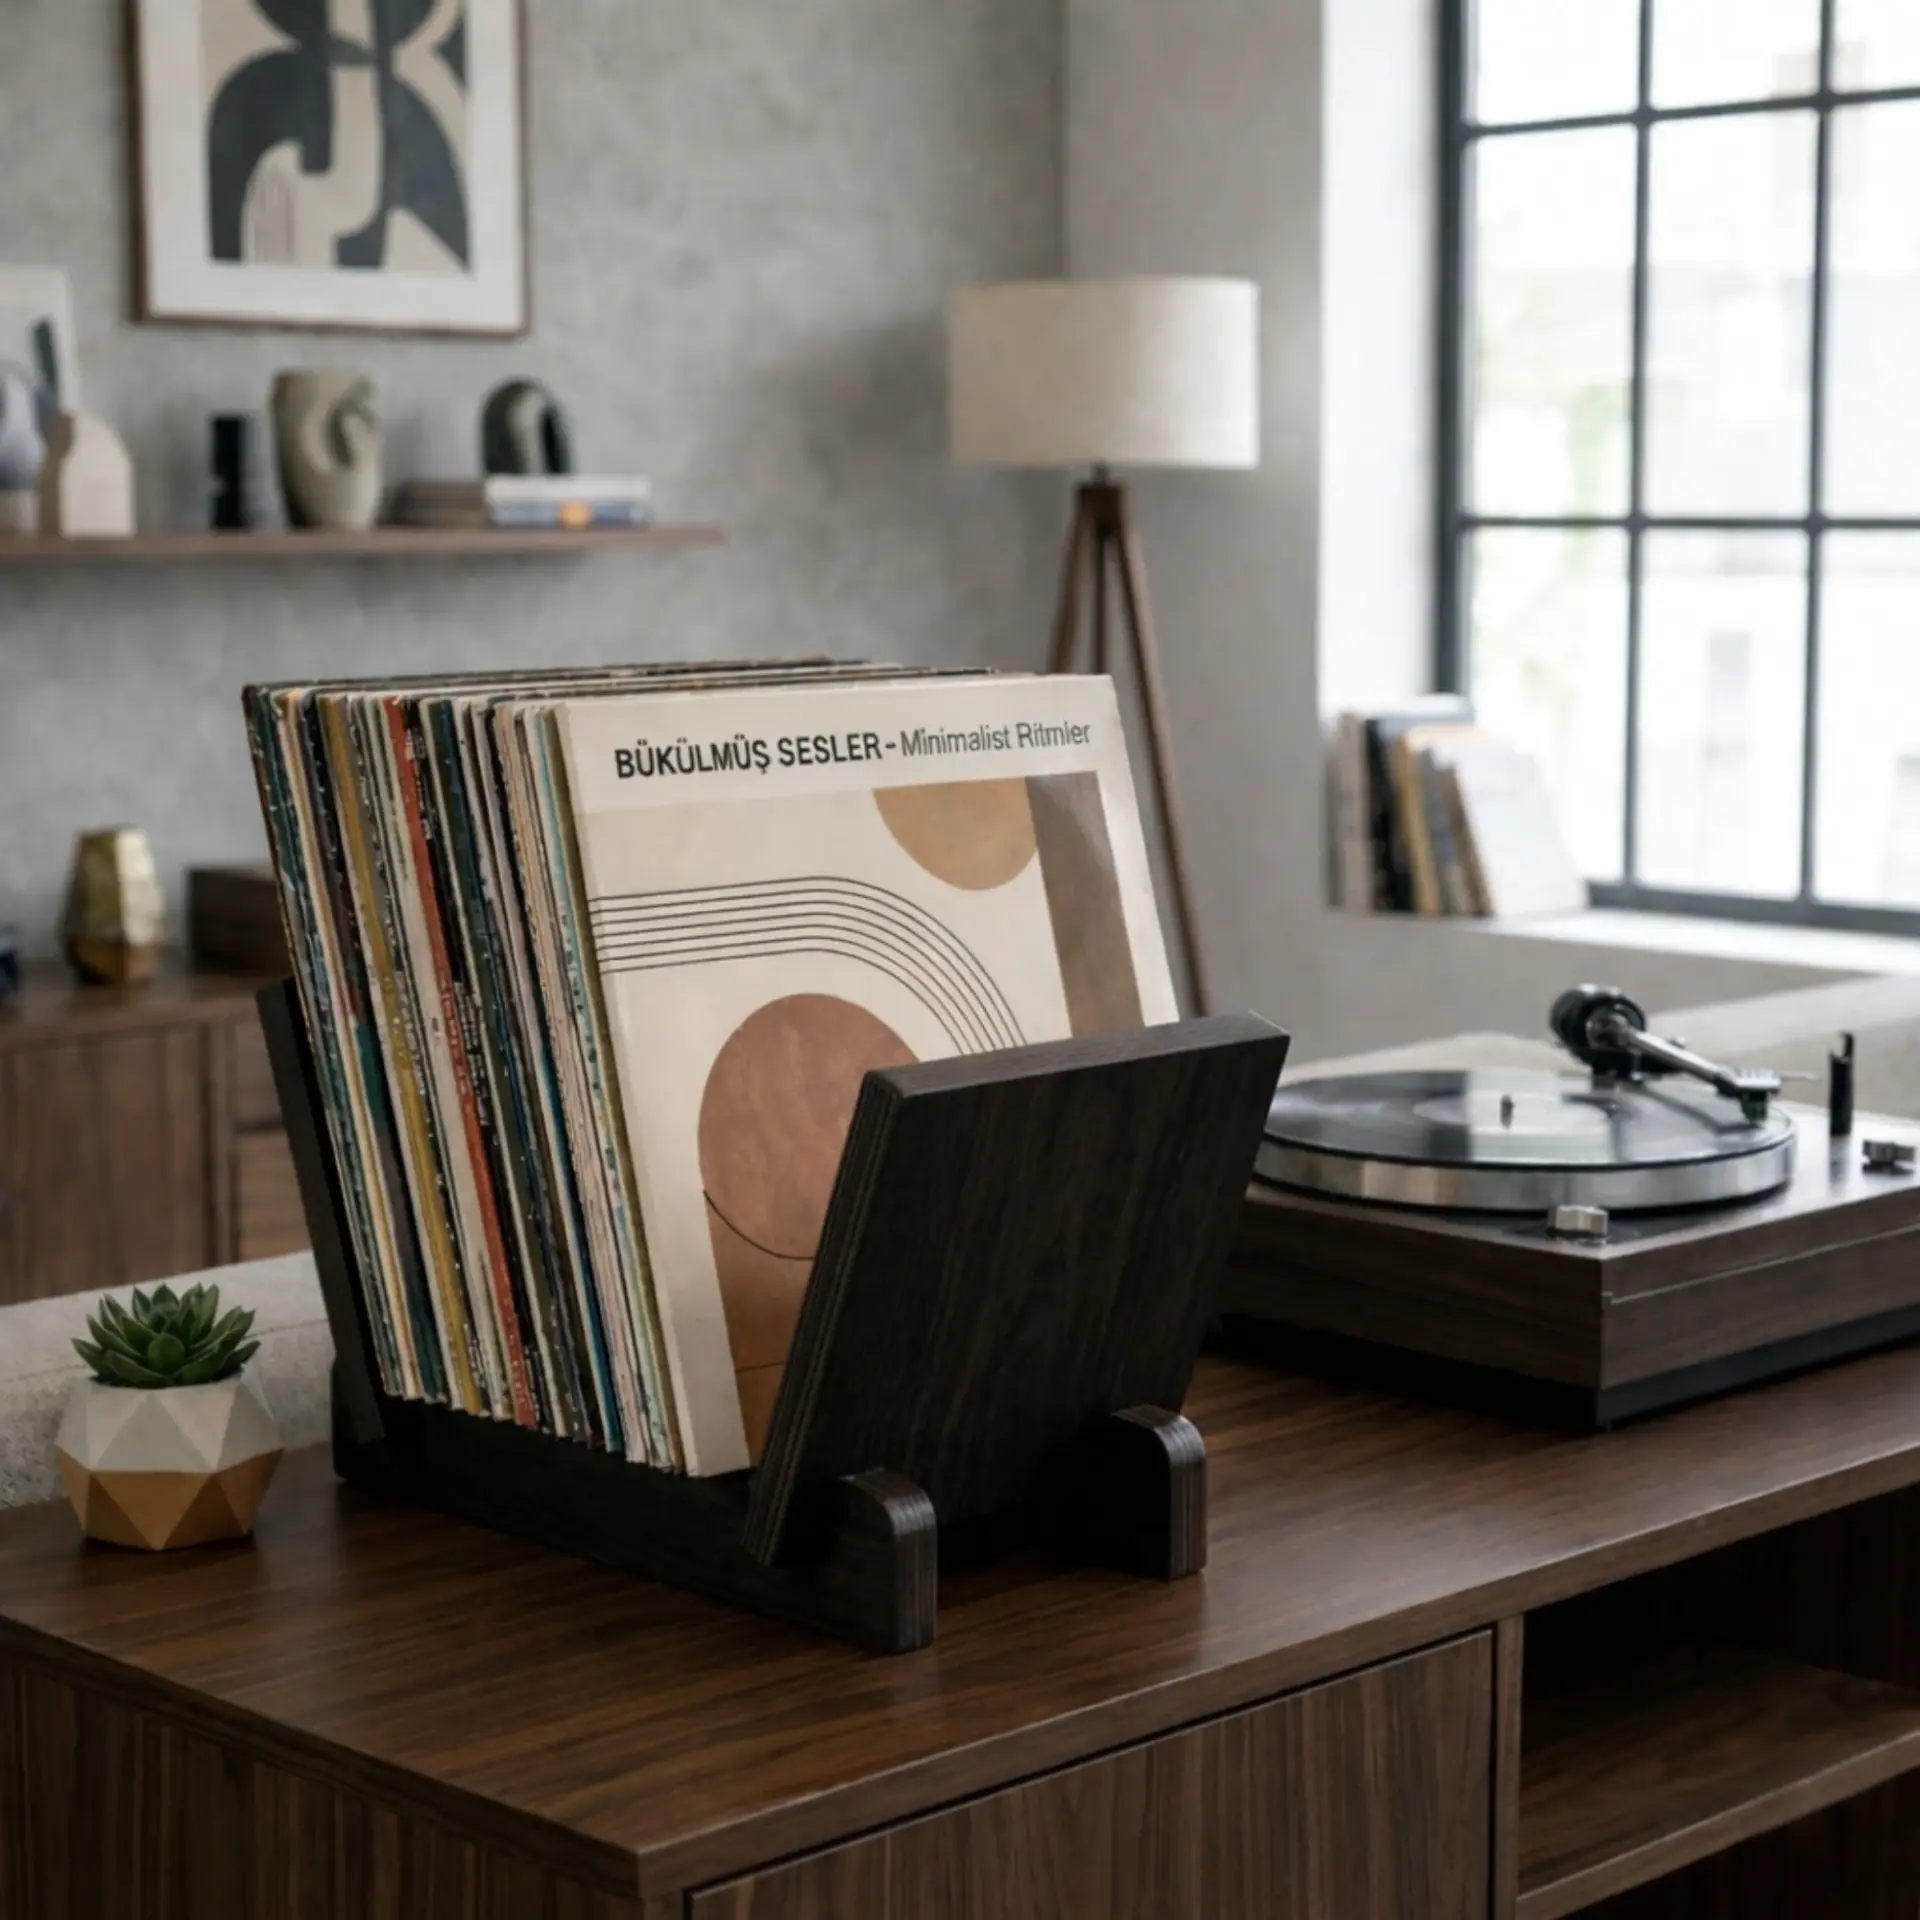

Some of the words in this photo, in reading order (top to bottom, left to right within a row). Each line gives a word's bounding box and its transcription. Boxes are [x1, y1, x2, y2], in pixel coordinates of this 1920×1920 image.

[614, 733, 771, 779] BÜKÜLMÜŞ
[900, 724, 1012, 757] Minimalist
[1016, 720, 1091, 749] Ritmler
